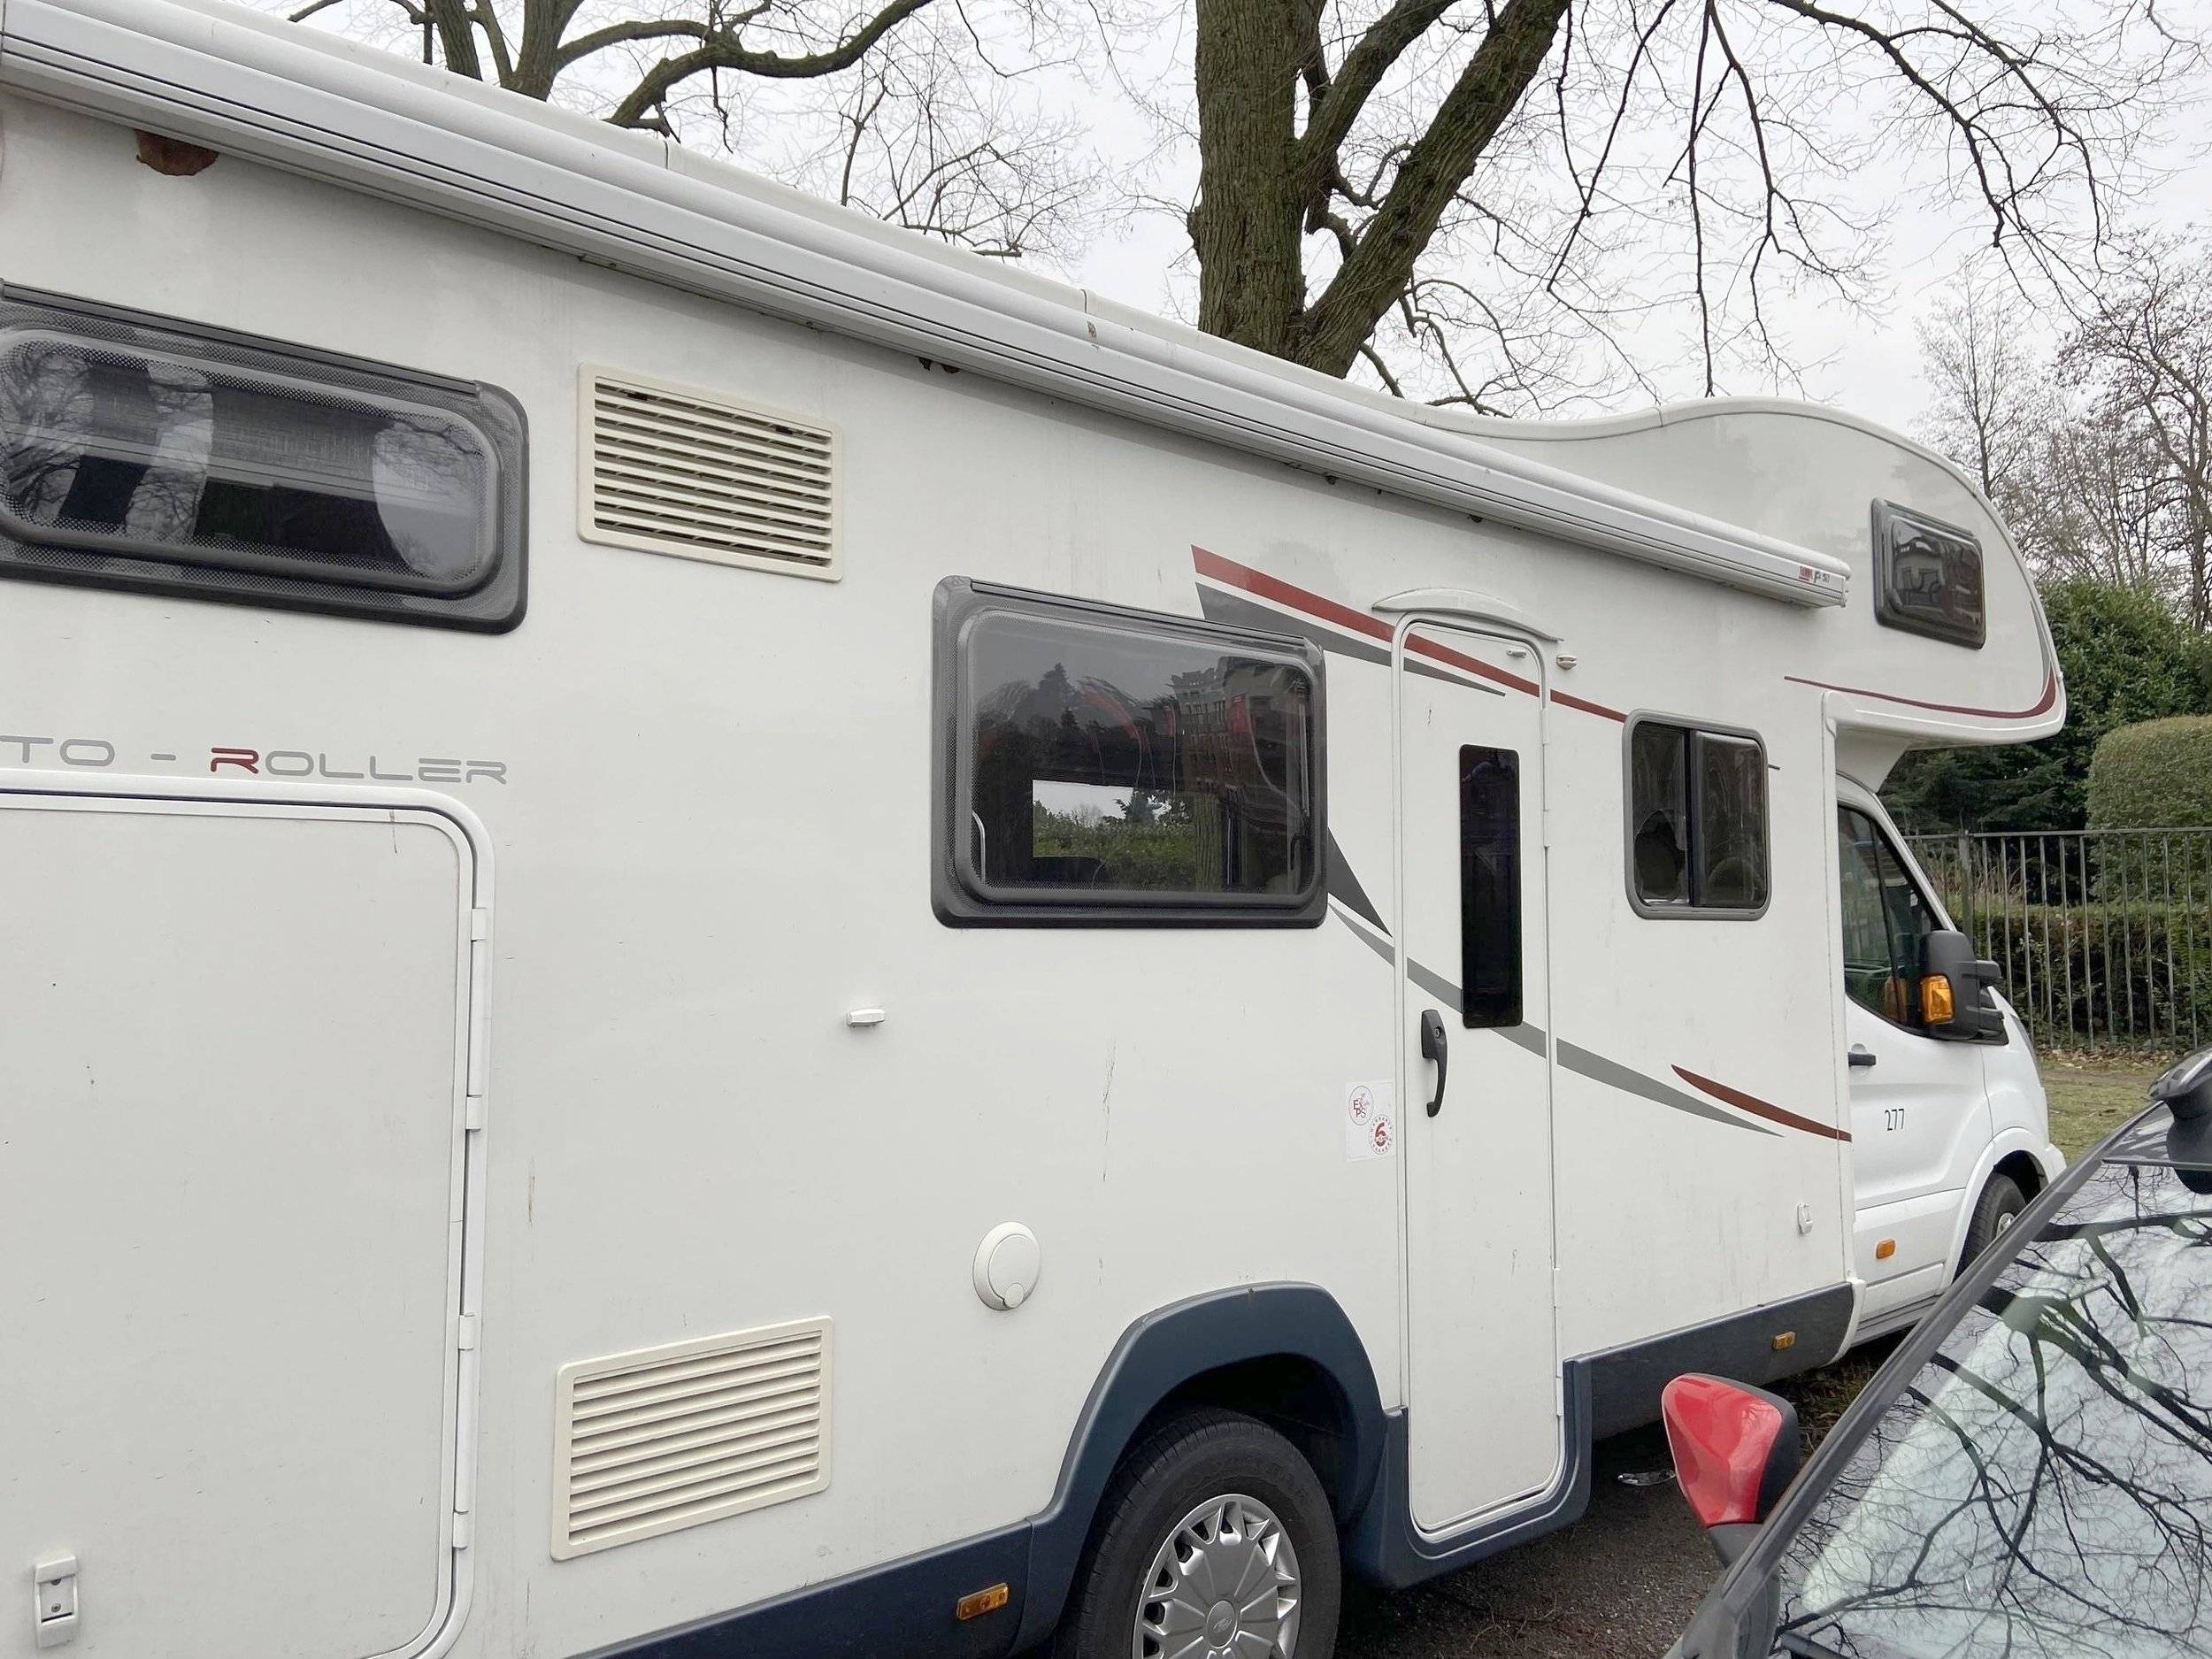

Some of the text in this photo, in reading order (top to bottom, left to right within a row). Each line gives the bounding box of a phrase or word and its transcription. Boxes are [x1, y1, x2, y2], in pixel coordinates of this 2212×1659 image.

[0, 735, 115, 767] TO
[211, 747, 507, 785] ROLLER
[1884, 1108, 1905, 1132] 277
[1374, 1122, 1387, 1147] 6
